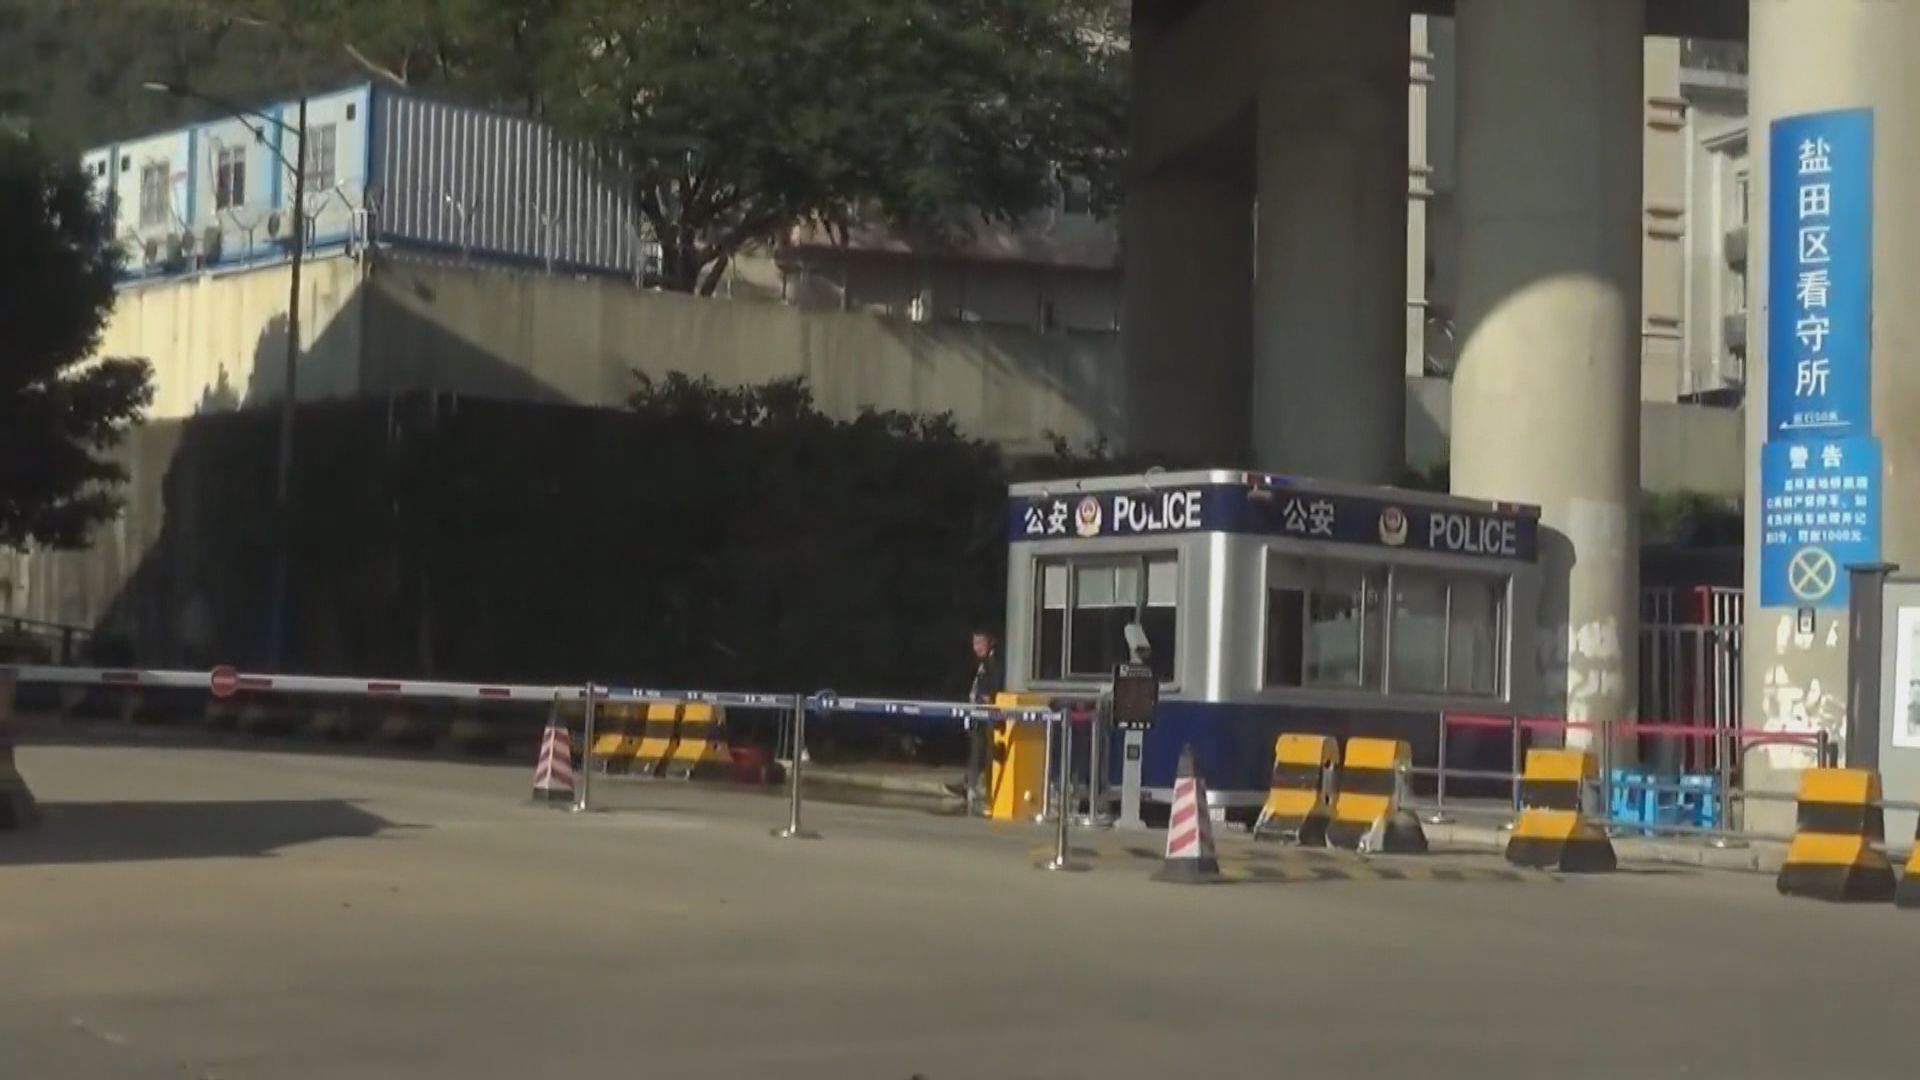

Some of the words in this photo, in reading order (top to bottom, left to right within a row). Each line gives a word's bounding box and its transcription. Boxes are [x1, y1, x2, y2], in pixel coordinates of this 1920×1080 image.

[1796, 137, 1831, 396] 盐田区看守所
[1024, 500, 1068, 534] 公安
[1283, 498, 1334, 536] 公安
[1429, 512, 1517, 556] POLICE
